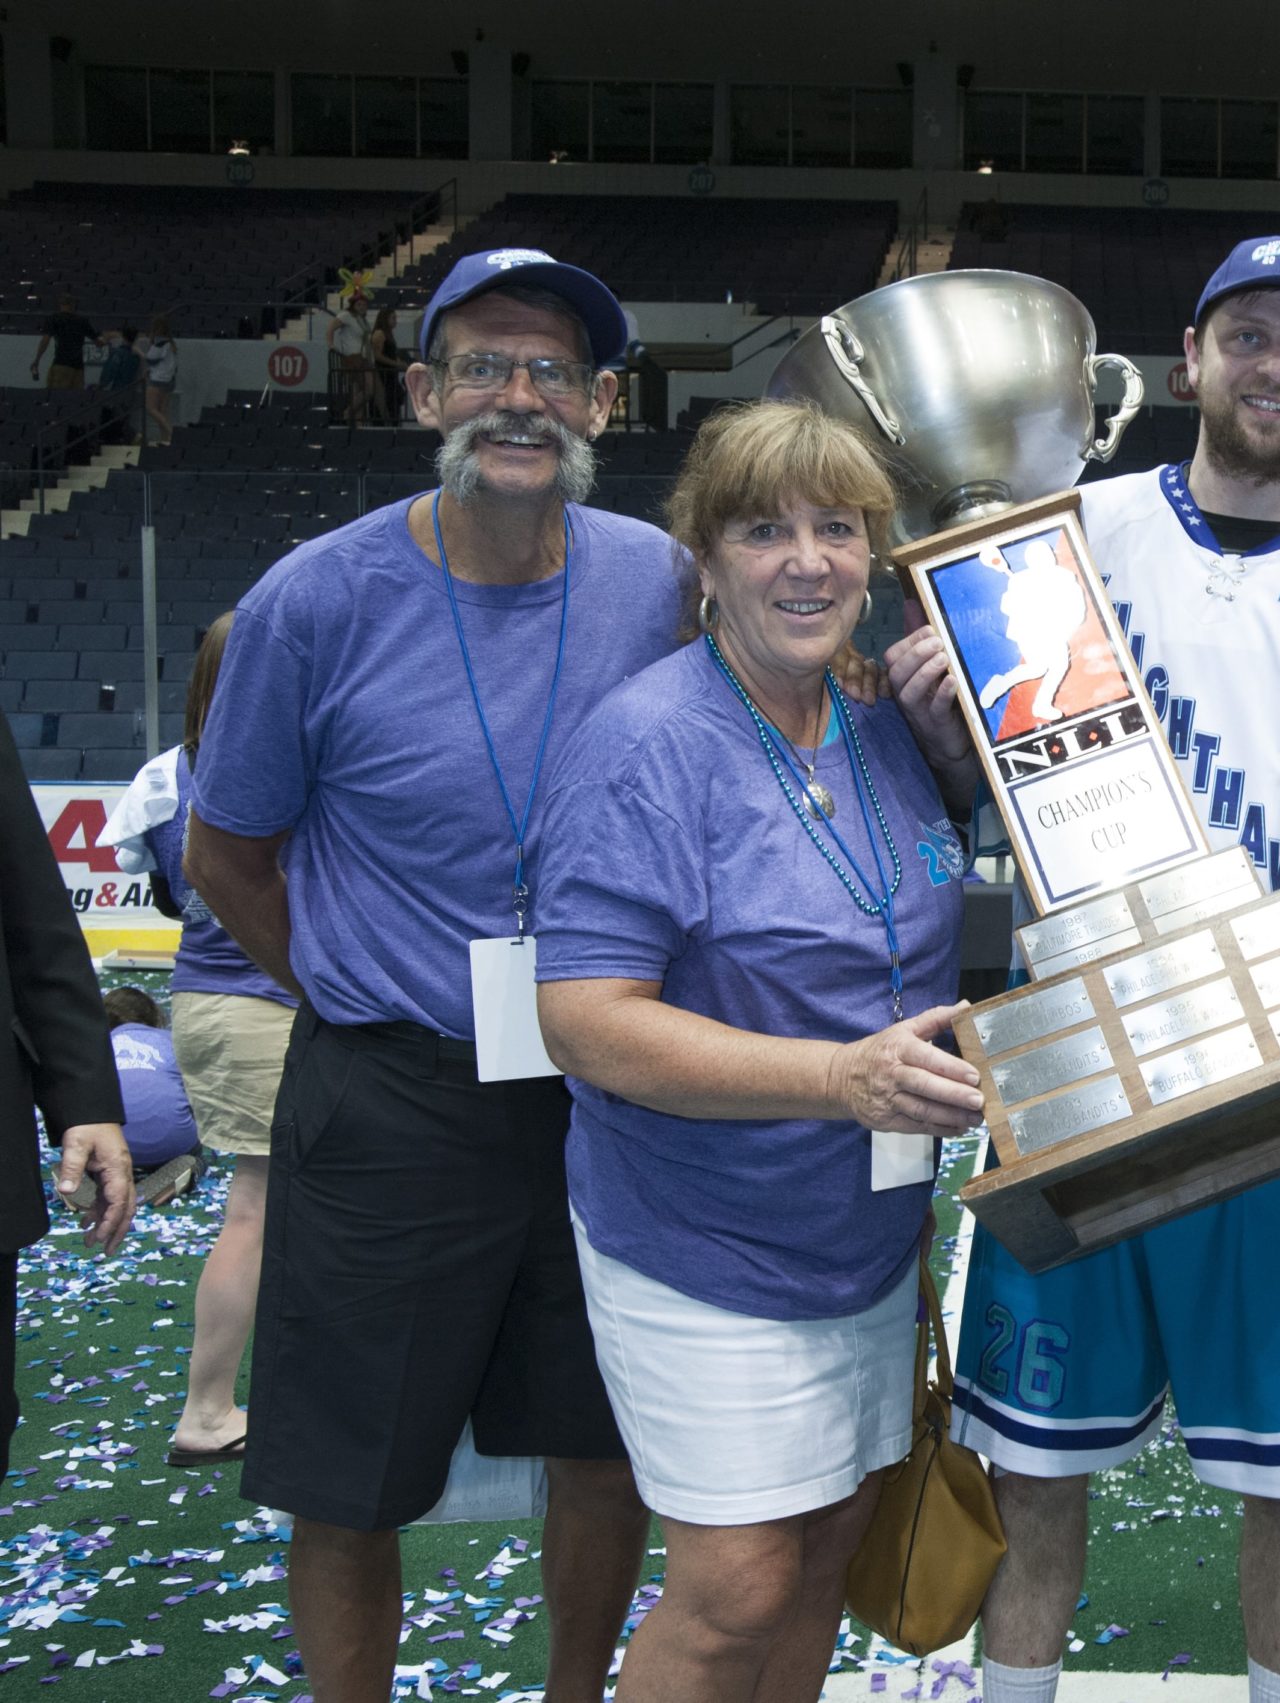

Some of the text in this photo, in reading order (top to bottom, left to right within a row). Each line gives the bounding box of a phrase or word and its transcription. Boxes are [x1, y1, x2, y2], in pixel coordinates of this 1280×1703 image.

[691, 174, 712, 189] 207
[1144, 186, 1167, 200] 206
[273, 355, 303, 378] 107
[1037, 770, 1153, 829] CHAMPION'S
[1090, 821, 1128, 853] CUP
[1164, 998, 1195, 1019] 1995
[1155, 1064, 1206, 1094] BUFFALO
[1071, 1097, 1119, 1126] BANDITS
[976, 1302, 1071, 1412] 26
